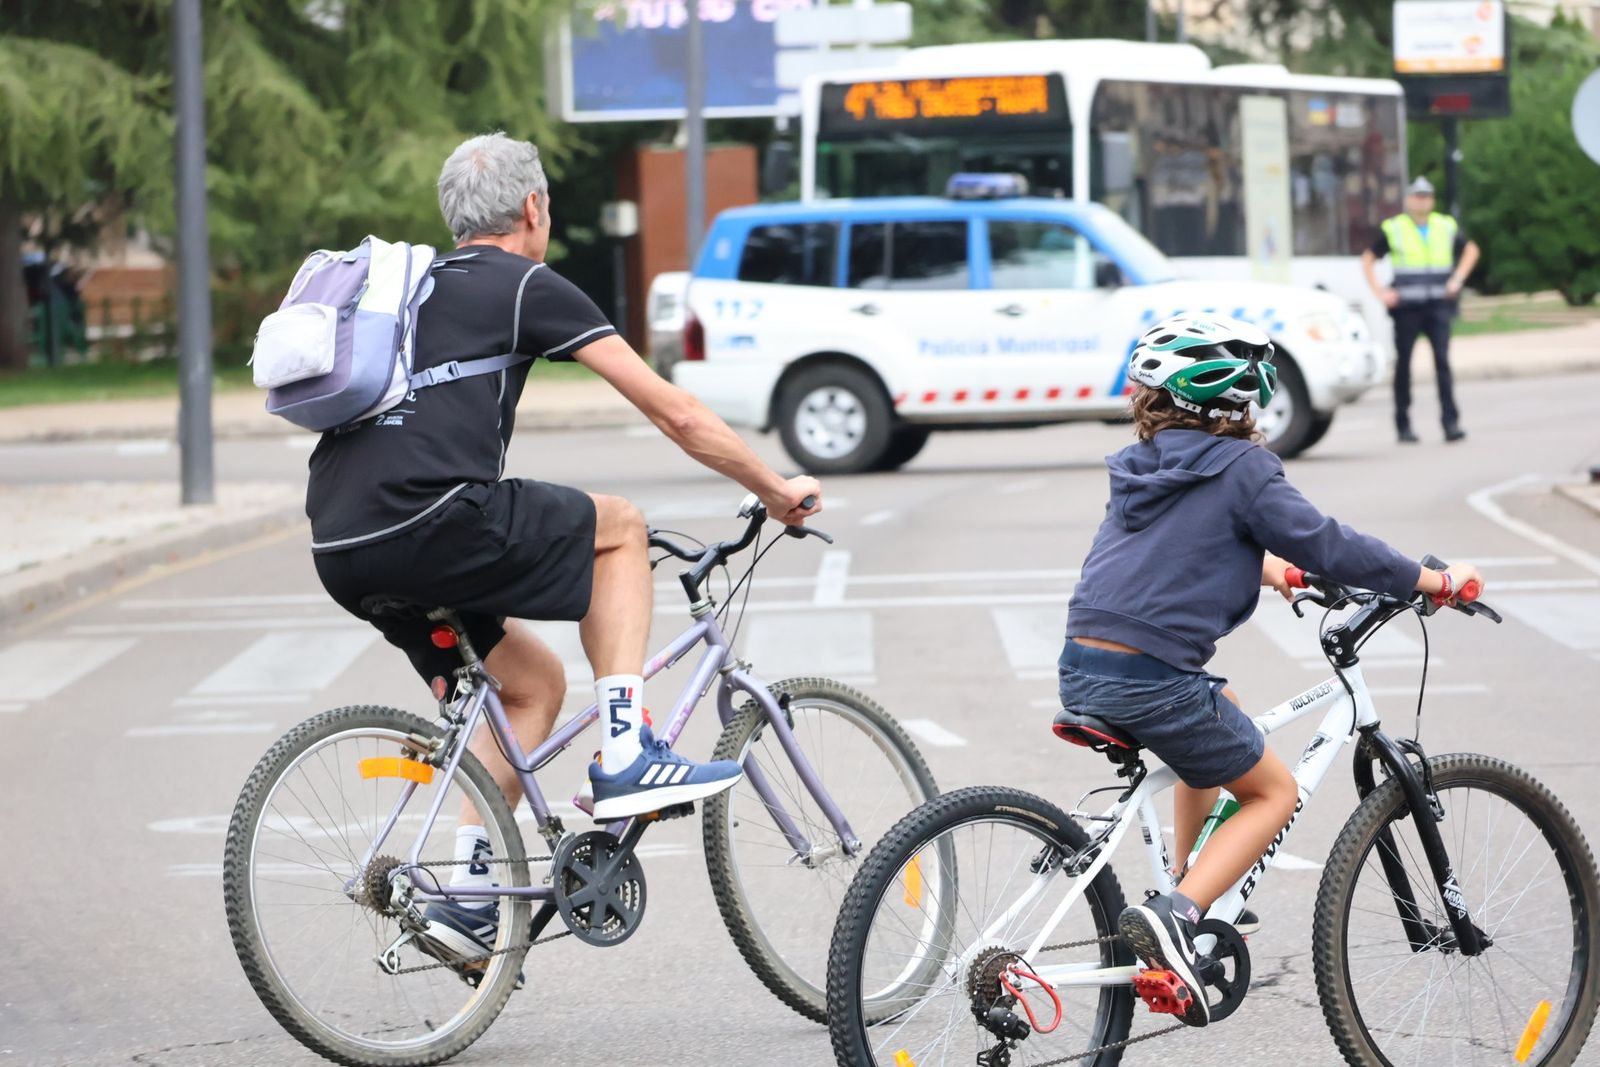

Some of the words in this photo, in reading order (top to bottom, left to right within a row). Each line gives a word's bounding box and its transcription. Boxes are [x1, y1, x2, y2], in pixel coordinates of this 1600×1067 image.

[714, 299, 765, 320] 112
[996, 335, 1099, 355] Municipal
[1289, 682, 1333, 712] ROCKRIDER
[608, 687, 633, 738] FILA
[468, 838, 494, 876] ILA
